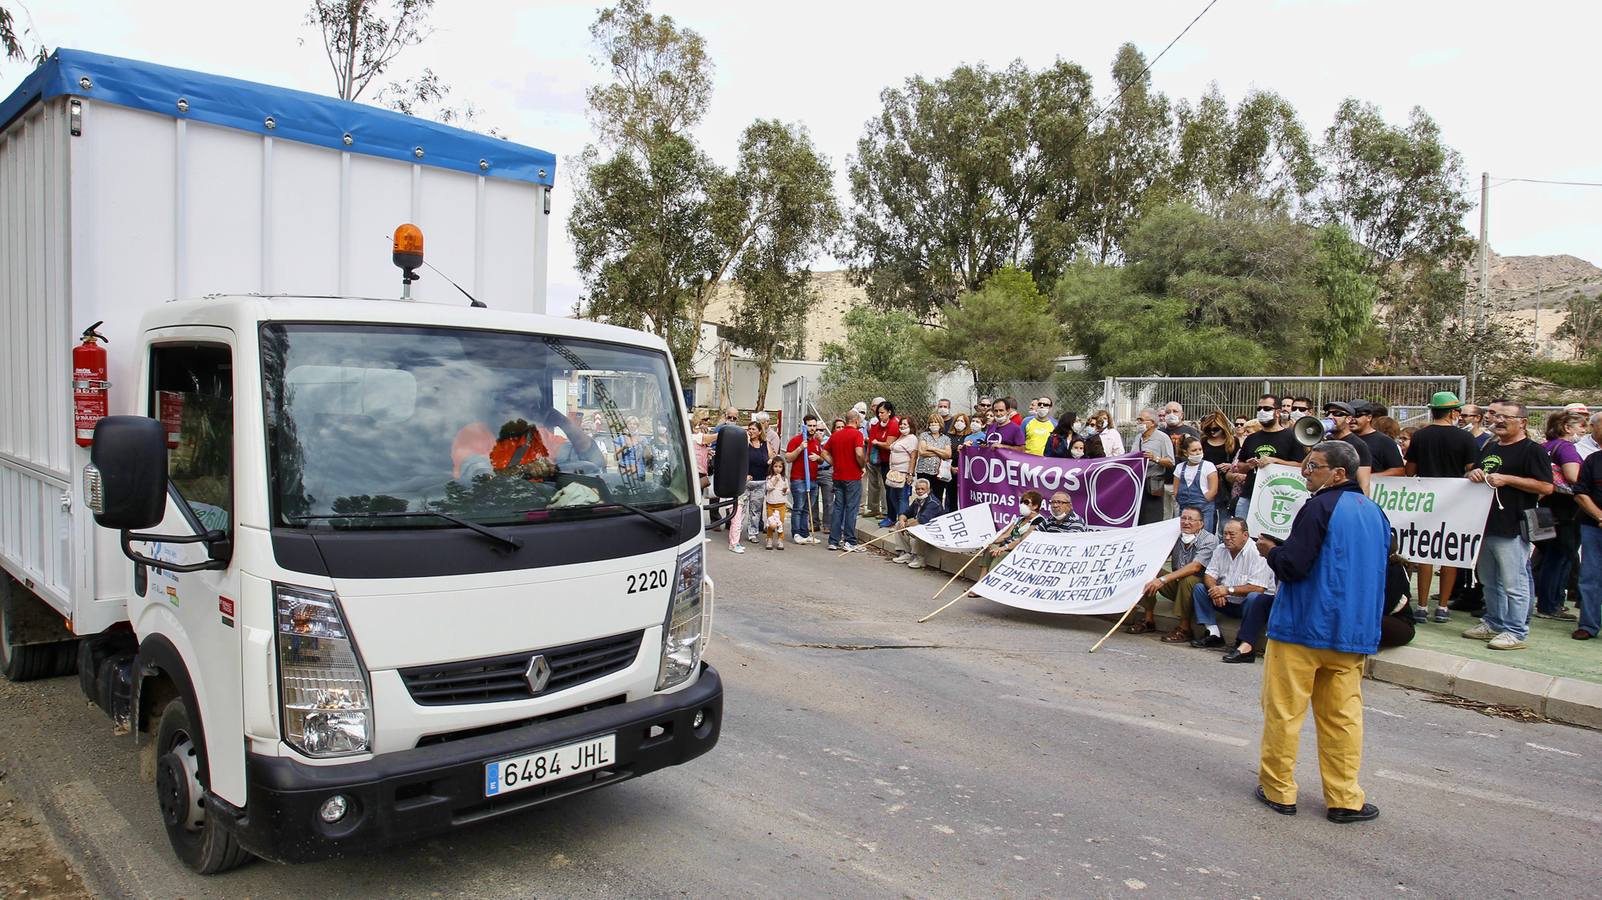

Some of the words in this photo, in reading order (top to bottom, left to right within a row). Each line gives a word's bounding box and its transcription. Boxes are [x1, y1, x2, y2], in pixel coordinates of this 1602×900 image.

[1372, 483, 1435, 512] lbatera
[1017, 541, 1077, 558] ALICANTE
[1082, 546, 1100, 558] NO
[1100, 543, 1117, 557] ES
[1120, 541, 1135, 554] EL
[1390, 522, 1481, 562] rtedero
[994, 564, 1061, 587] COMUNIDAD
[1012, 554, 1087, 575] VERTEDERO
[1091, 558, 1112, 573] DE
[1115, 555, 1135, 570] LA
[626, 568, 668, 595] 2220
[981, 575, 1000, 588] NO
[999, 581, 1013, 591] A
[1010, 585, 1030, 596] LA
[1029, 585, 1118, 601] INCINERACION
[504, 752, 562, 787] 6484
[571, 741, 609, 771] JHL
